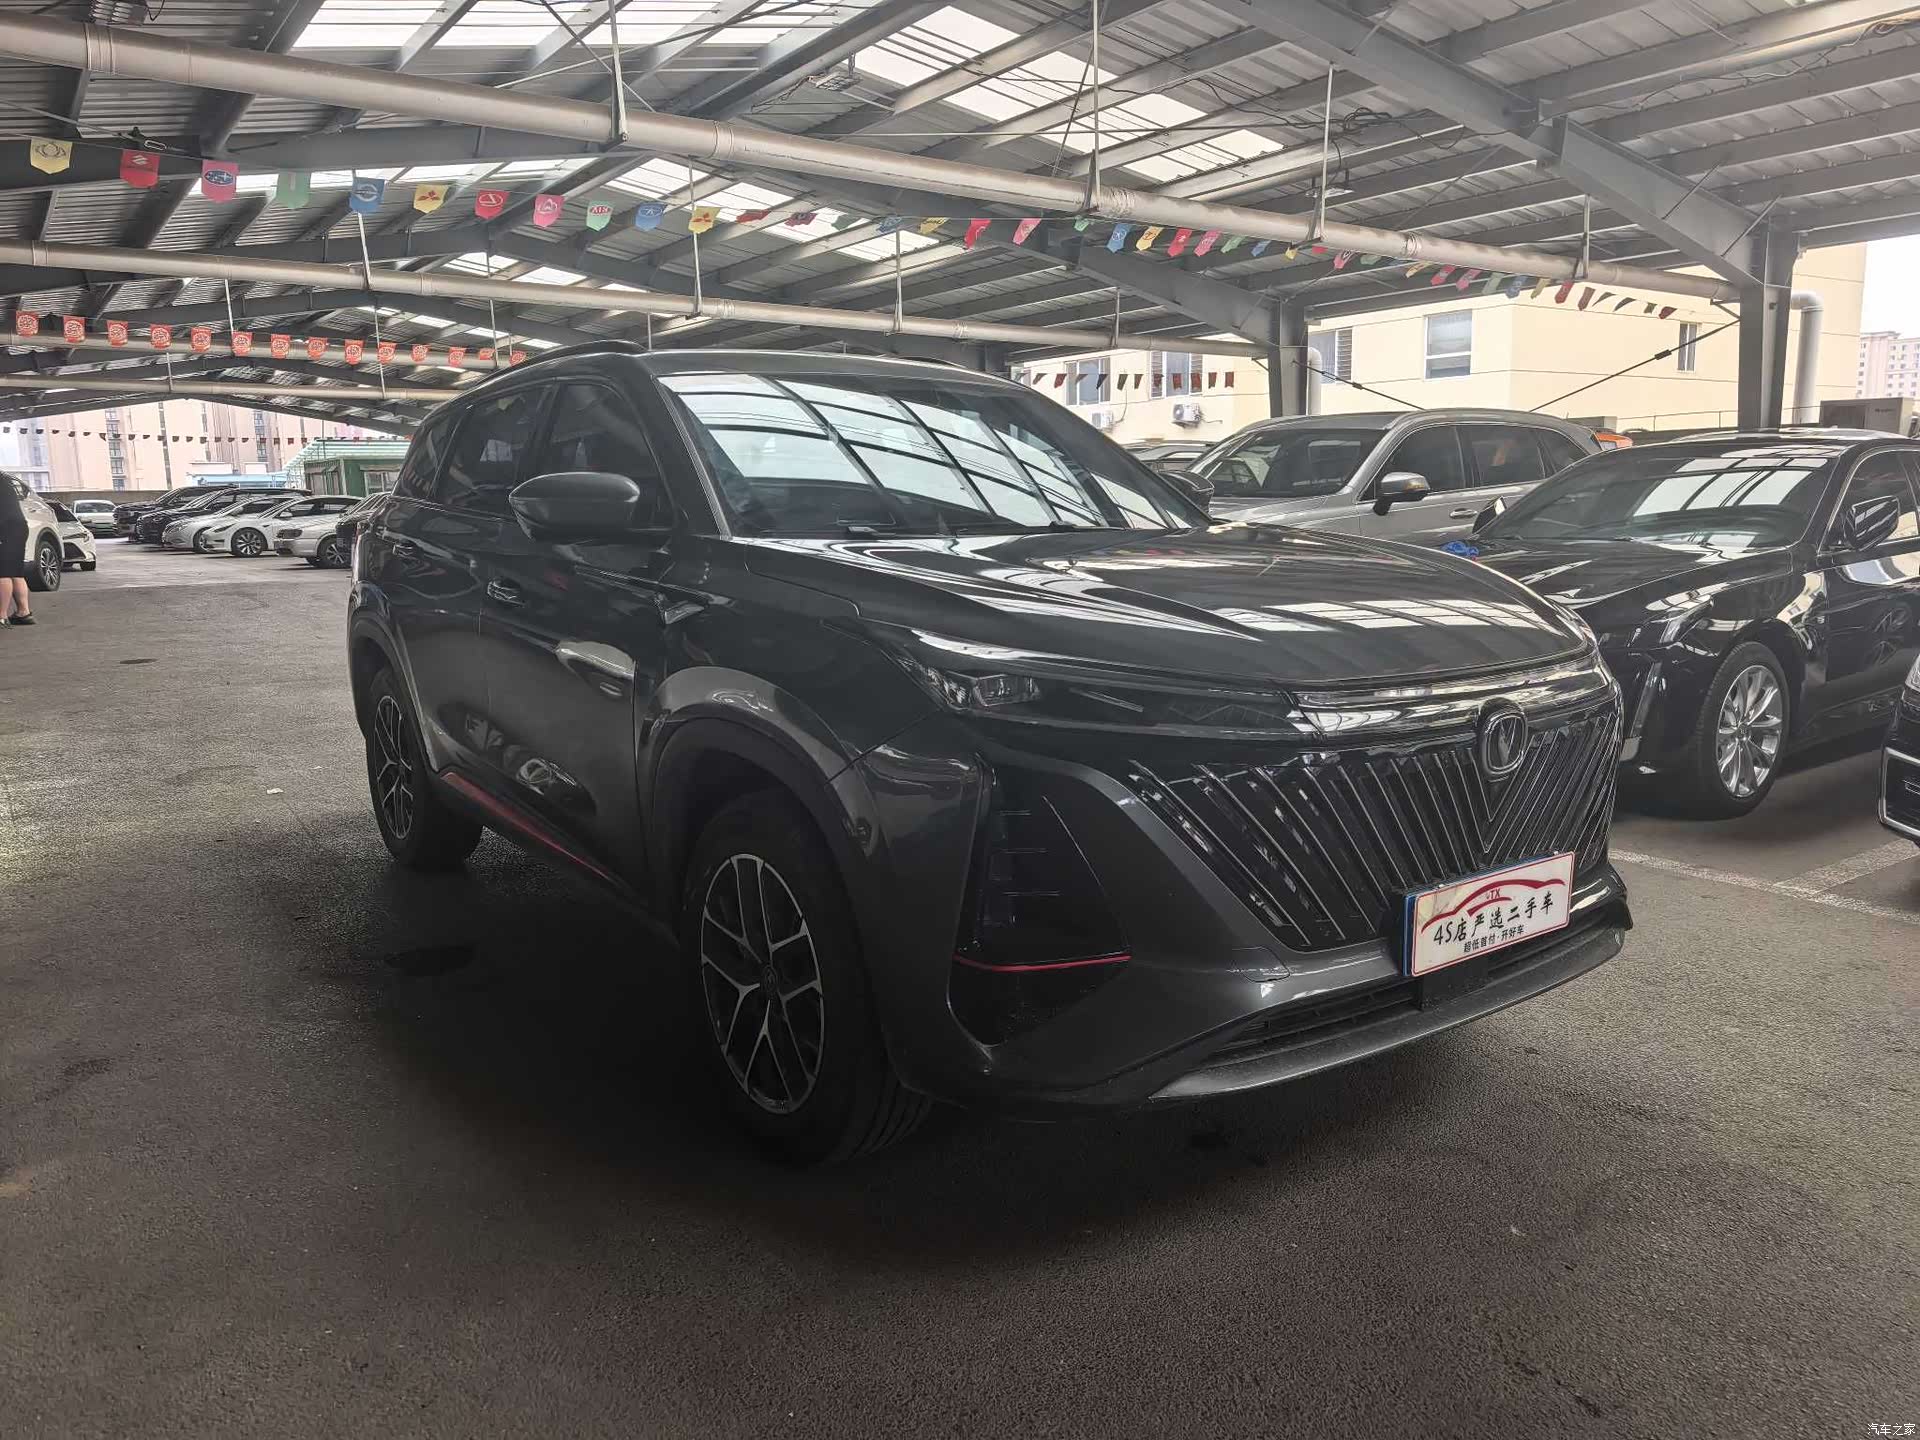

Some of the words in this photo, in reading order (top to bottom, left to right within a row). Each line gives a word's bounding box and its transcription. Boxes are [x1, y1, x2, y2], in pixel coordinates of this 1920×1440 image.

[1433, 892, 1553, 945] 4S店严选二手车
